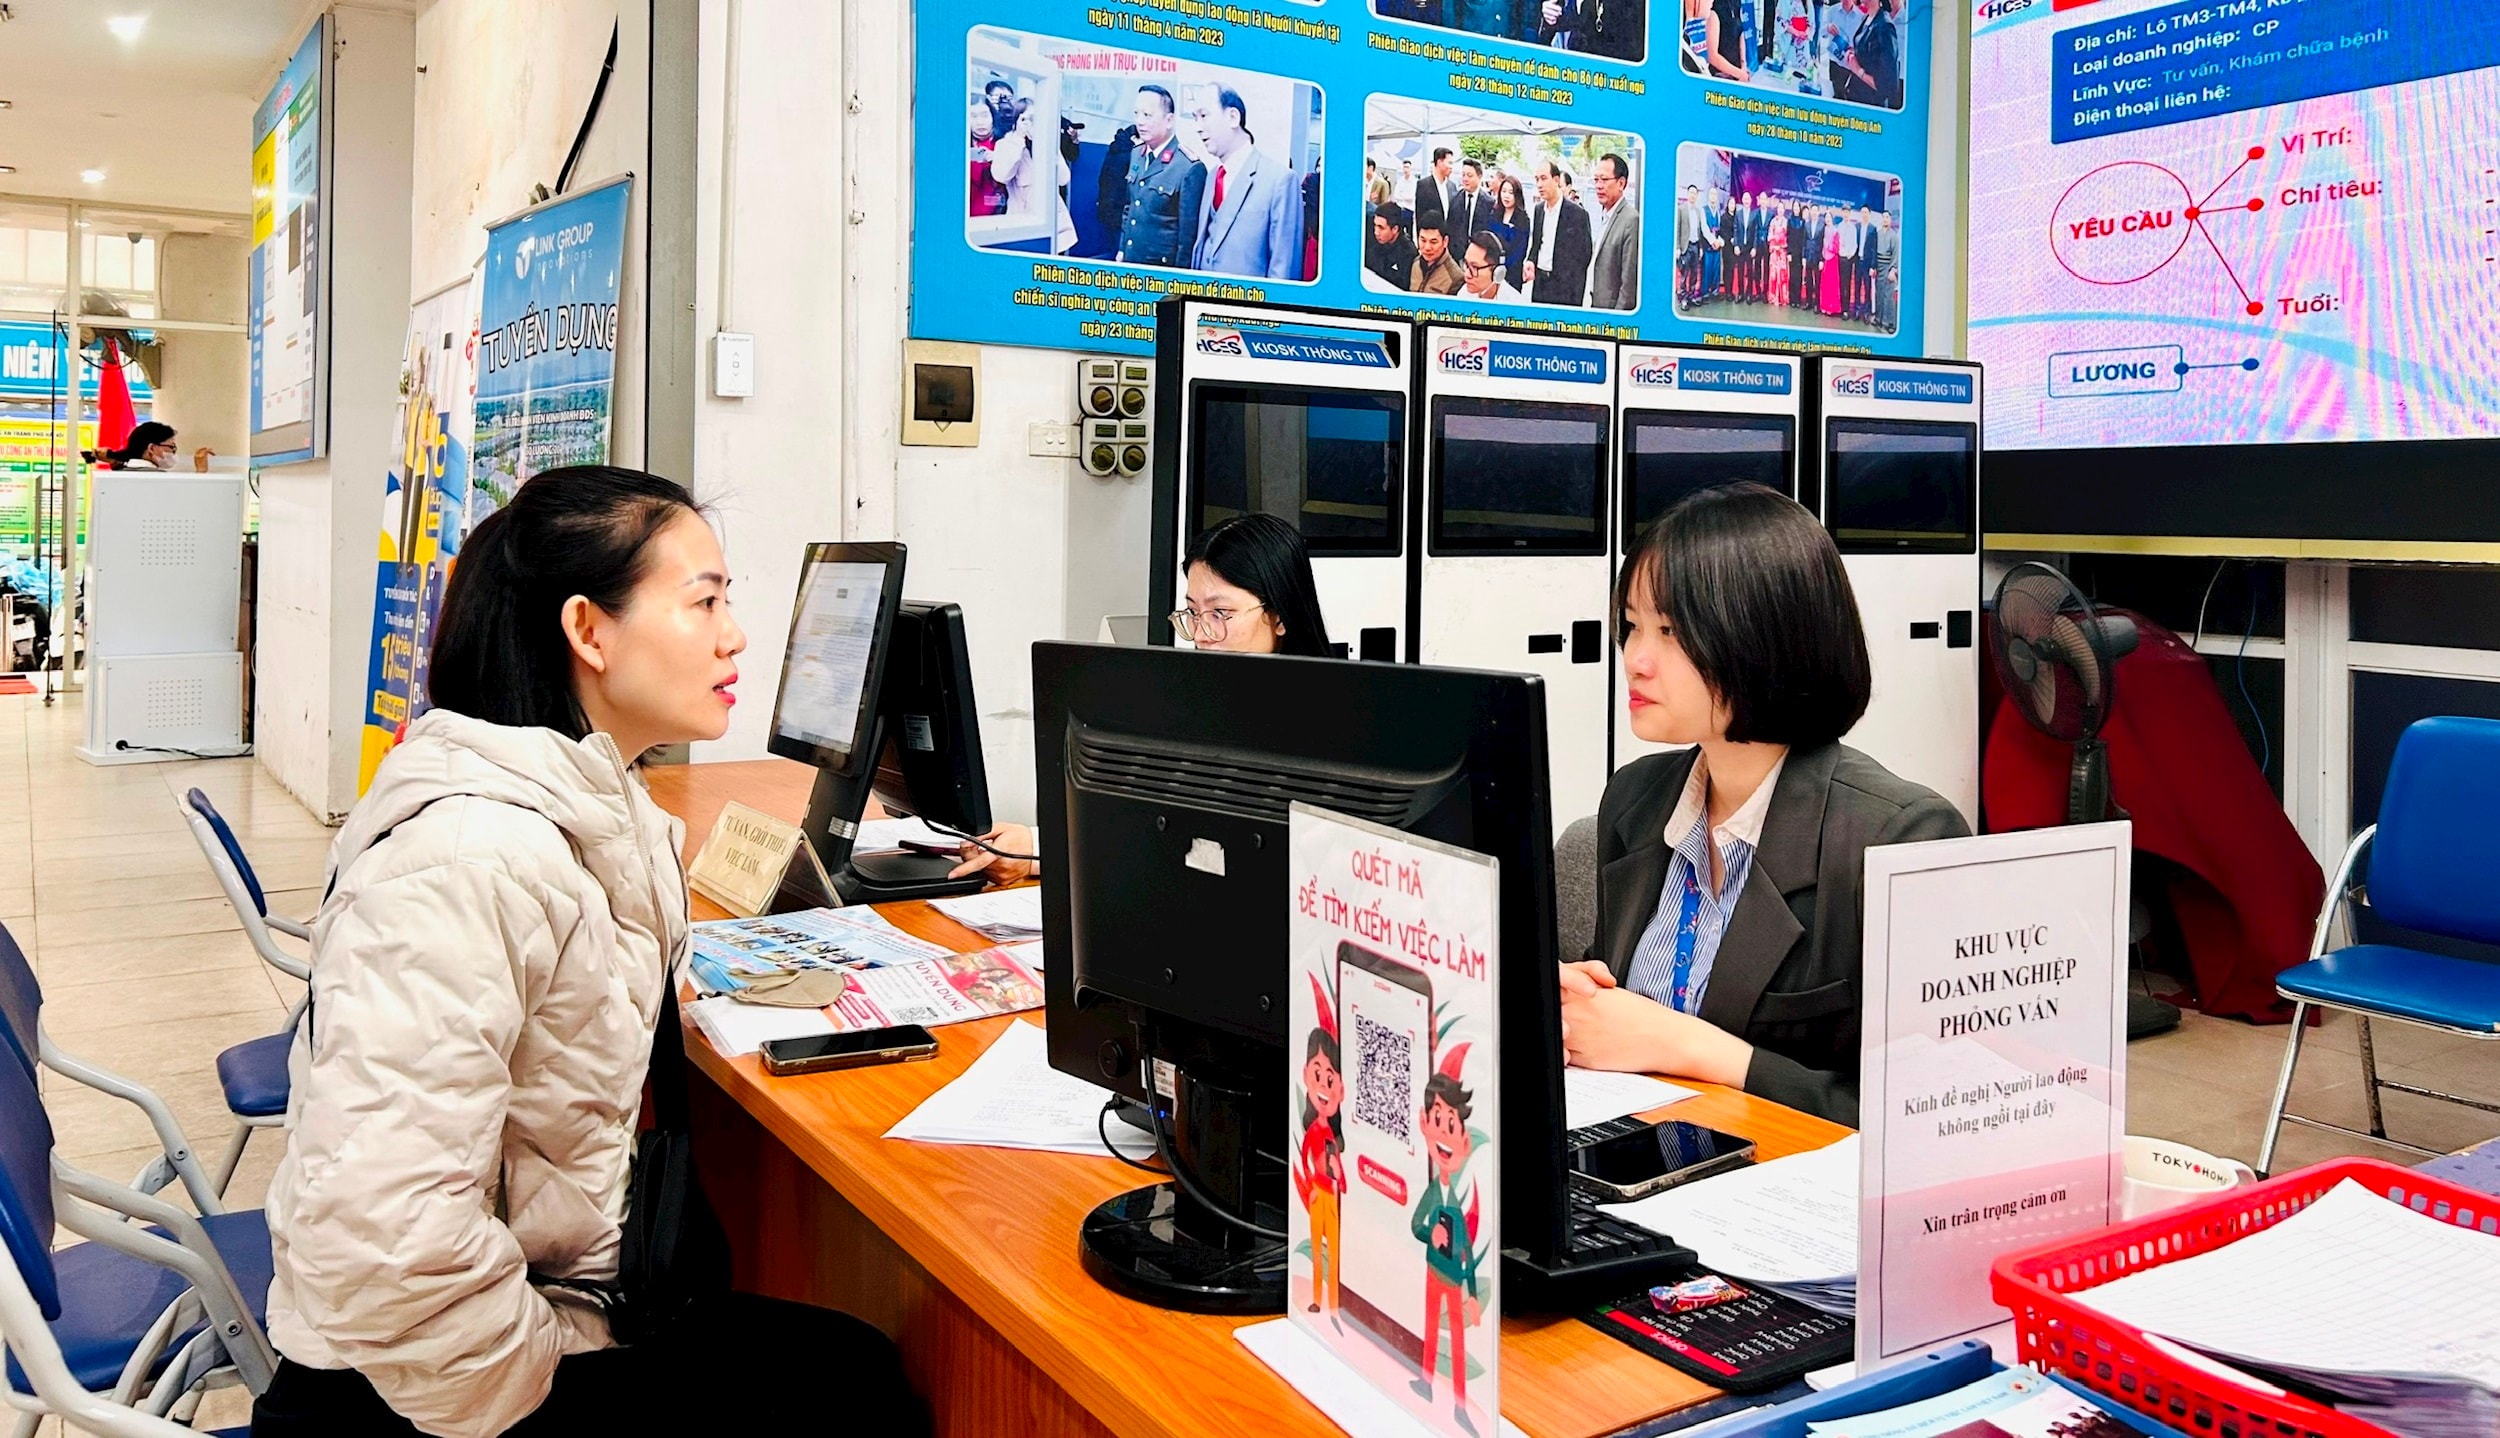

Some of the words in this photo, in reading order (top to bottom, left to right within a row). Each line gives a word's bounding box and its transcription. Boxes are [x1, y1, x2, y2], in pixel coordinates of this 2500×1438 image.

[1088, 8, 1115, 29] ngày
[1117, 12, 1130, 30] 11
[1133, 14, 1163, 38] tháng
[1164, 20, 1172, 37] 4
[1174, 21, 1197, 42] năm
[1198, 25, 1225, 47] 2023
[1207, 4, 1223, 19] lao
[1225, 5, 1250, 27] động
[1252, 10, 1262, 27] là
[1263, 12, 1293, 34] Người
[1294, 16, 1326, 42] khuyết
[2074, 34, 2101, 52] Địa
[2146, 18, 2167, 36] Lô
[2171, 0, 2262, 28] TM3-TM4,
[1368, 32, 1397, 52] Phiên
[1399, 36, 1421, 55] Giao
[1423, 40, 1444, 62] dịch
[1446, 46, 1467, 66] việc
[1468, 48, 1487, 68] làm
[1489, 53, 1522, 74] chuyên
[1537, 60, 1560, 81] dành
[1561, 64, 1578, 82] cho
[1579, 68, 1591, 88] Bộ
[1593, 70, 1607, 91] đội
[1608, 73, 1628, 91] xuất
[2073, 57, 2108, 76] Loại
[2112, 44, 2167, 67] doanh
[2172, 29, 2241, 56] nghiệp:
[2252, 19, 2280, 37] CP
[2073, 84, 2109, 102] Lĩnh
[2113, 76, 2152, 95] Vực:
[2162, 69, 2186, 84] Tư
[2189, 60, 2224, 79] vấn,
[2229, 51, 2281, 71] Khám
[2286, 38, 2334, 60] chữa
[2339, 28, 2390, 50] bệnh
[1449, 73, 1472, 90] ngày
[1474, 77, 1486, 93] 28
[1487, 78, 1514, 98] tháng
[1516, 82, 1528, 98] 12
[1529, 83, 1549, 101] năm
[1551, 87, 1573, 105] 2023
[2073, 107, 2111, 126] Điện
[2115, 97, 2160, 118] thoại
[2165, 92, 2197, 109] liên
[2202, 85, 2231, 101] hệ:
[1705, 91, 1727, 107] Phiên
[1728, 95, 1745, 111] Giao
[1747, 98, 1763, 115] dịch
[1764, 102, 1780, 119] việc
[1869, 119, 1882, 134] Anh
[1747, 122, 1765, 138] ngày
[1766, 124, 1776, 138] 28
[1777, 126, 1797, 143] tháng
[1799, 128, 1808, 142] 10
[1825, 133, 1843, 148] 2023
[2281, 134, 2304, 154] Vị
[2312, 127, 2352, 148] Trí:
[2327, 179, 2383, 200] tiêu:
[535, 232, 556, 257] LINK
[557, 221, 594, 251] GROUP
[2069, 216, 2115, 240] YÊU
[2121, 209, 2172, 236] CẦU
[1033, 264, 1065, 284] Phiên
[1067, 266, 1092, 287] Giao
[1094, 269, 1118, 292] dịch
[1120, 271, 1143, 293] việc
[1145, 274, 1165, 294] làm
[1221, 282, 1245, 300] dành
[1247, 286, 1265, 301] cho
[1014, 288, 1045, 306] chiến
[1048, 291, 1059, 307] sĩ
[1060, 293, 1091, 311] nghĩa
[1093, 297, 1107, 314] vụ
[1109, 296, 1135, 316] công
[1137, 302, 1150, 316] an
[2278, 292, 2339, 315] Tuổi:
[556, 303, 618, 356] DỤNG
[1081, 321, 1107, 338] ngày
[1109, 322, 1123, 338] 23
[1125, 323, 1155, 342] tháng
[3, 339, 59, 380] NIÊM
[1251, 341, 1301, 358] KIOSK
[1301, 344, 1353, 362] THÔNG
[1353, 349, 1379, 364] TIN
[1444, 352, 1484, 372] HCES
[1493, 355, 1533, 372] KIOSK
[1534, 356, 1577, 374] THÔNG
[1578, 361, 1598, 375] TIN
[1636, 369, 1673, 385] HCES
[1683, 370, 1720, 385] KIOSK
[1723, 369, 1764, 386] THÔNG
[1765, 372, 1784, 387] TIN
[1837, 379, 1869, 394] HCES
[1878, 380, 1911, 394] KIOSK
[1912, 379, 1950, 396] THÔNG
[1950, 384, 1966, 397] TIN
[2071, 361, 2156, 383] LƯƠNG
[1352, 846, 1391, 888] QUÉT
[1398, 858, 1424, 899] MÃ
[1298, 874, 1318, 918] ĐỂ
[1322, 887, 1349, 929] TÌM
[1353, 897, 1391, 945] KIẾM
[1397, 917, 1441, 967] VIỆC
[1446, 932, 1486, 982] LÀM
[1955, 932, 1999, 959] KHU
[2005, 923, 2048, 955] VỰC
[1921, 970, 1996, 1004] DOANH
[2001, 956, 2077, 990] NGHIỆP
[1940, 1004, 2012, 1038] PHỎNG
[2018, 993, 2060, 1023] VẤN
[1904, 1094, 1938, 1116] Kính
[1941, 1084, 1958, 1107] đề
[1961, 1083, 1990, 1107] nghị
[1993, 1073, 2033, 1099] Người
[2035, 1072, 2055, 1089] lao
[2057, 1065, 2088, 1086] động
[1938, 1118, 1980, 1137] không
[1983, 1103, 2011, 1129] ngồi
[2013, 1099, 2030, 1124] tại
[2033, 1098, 2057, 1119] đây
[1362, 1162, 1402, 1197] SCANNING
[1922, 1215, 1947, 1236] Xin
[1951, 1208, 1980, 1228] trân
[1983, 1199, 2018, 1221] trọng
[2021, 1191, 2047, 1210] cảm
[2050, 1188, 2067, 1202] ơn
